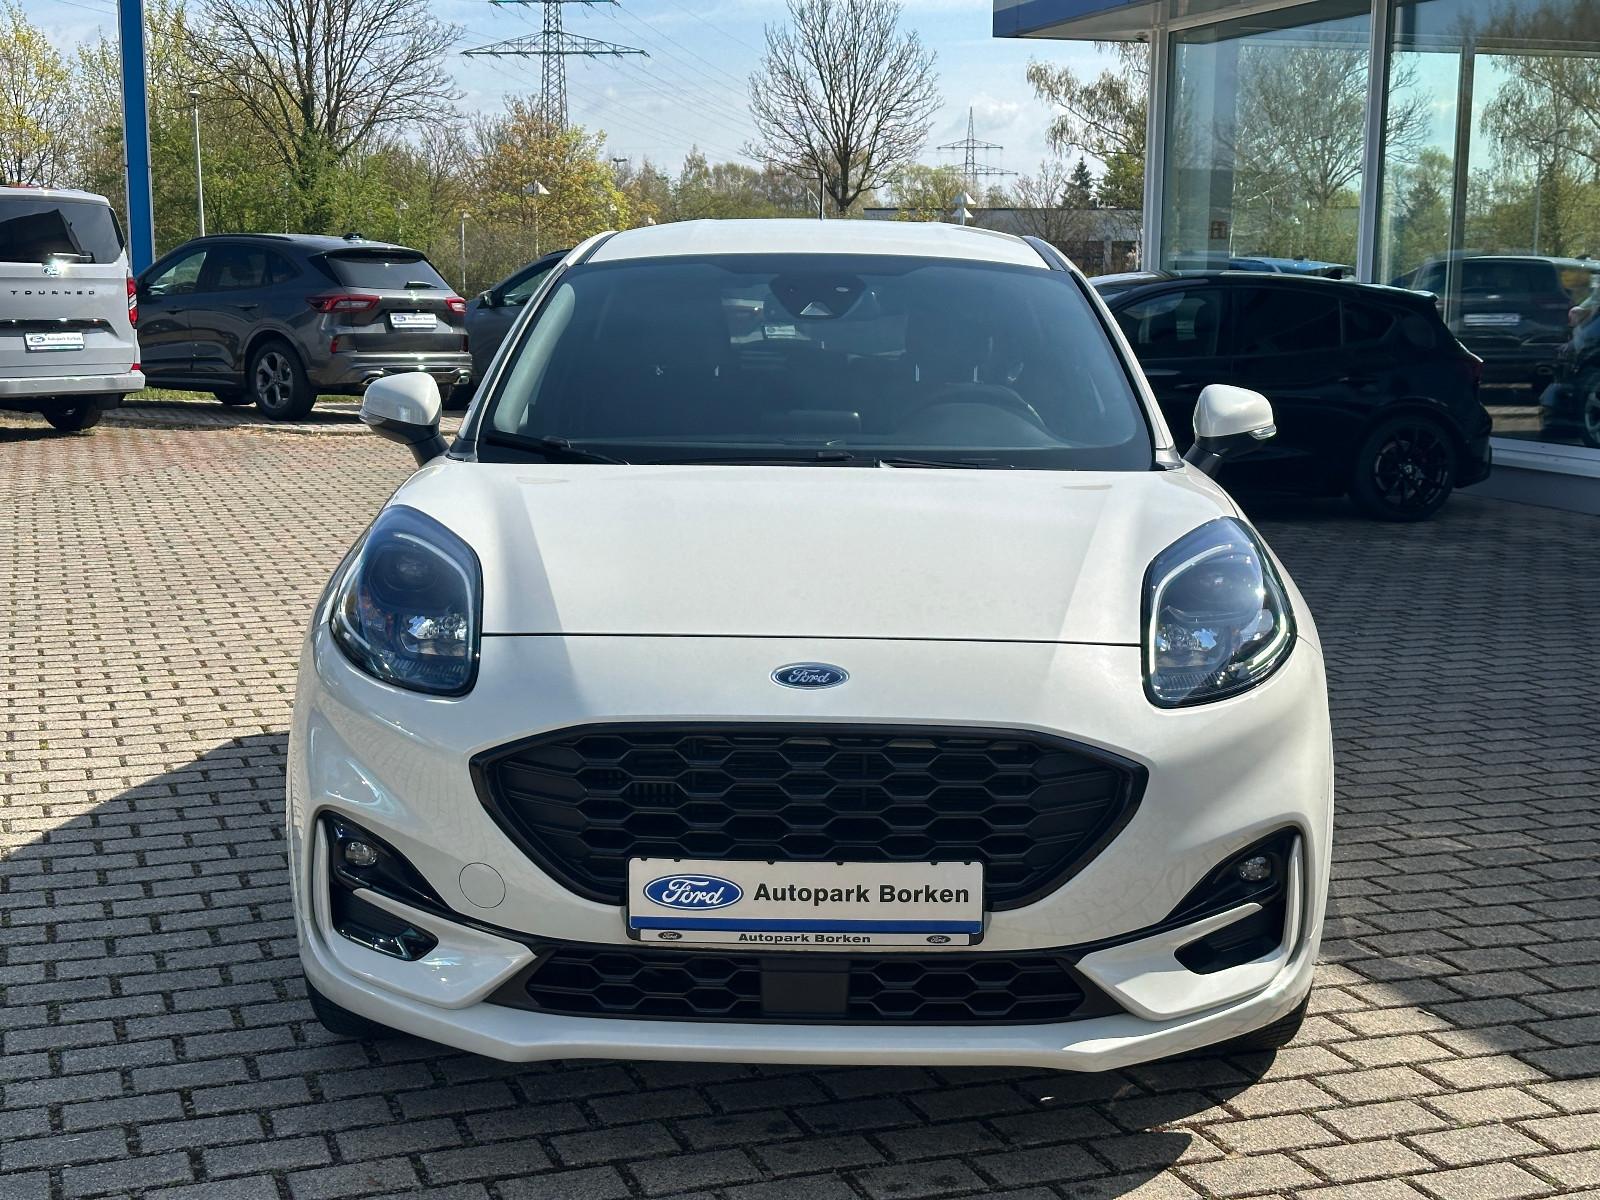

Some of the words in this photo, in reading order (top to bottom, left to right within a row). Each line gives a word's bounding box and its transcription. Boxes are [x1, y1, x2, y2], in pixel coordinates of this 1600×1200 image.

[662, 879, 725, 904] Ford
[754, 883, 870, 906] Autopark
[879, 885, 969, 903] Borken
[738, 933, 810, 944] Autopark
[814, 934, 871, 944] Borken
